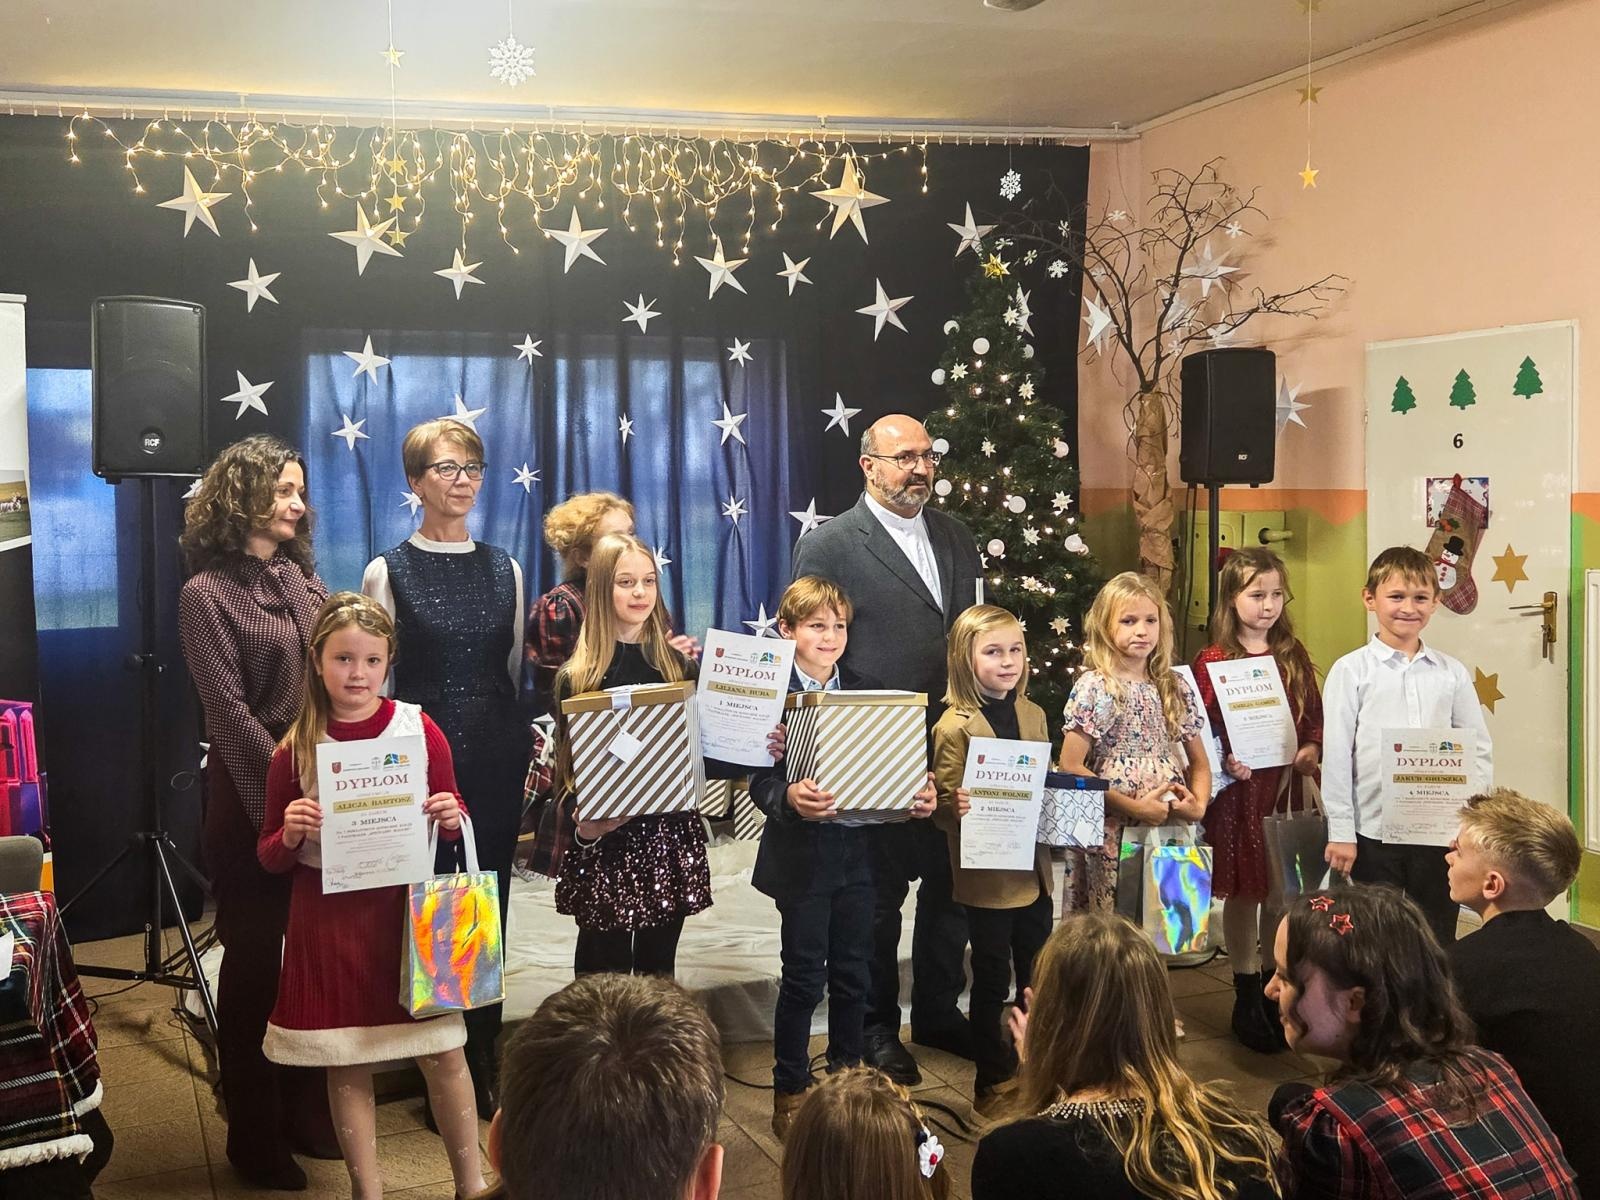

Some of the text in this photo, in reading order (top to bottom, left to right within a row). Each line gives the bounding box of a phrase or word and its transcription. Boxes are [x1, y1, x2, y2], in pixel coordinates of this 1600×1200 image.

[144, 438, 160, 447] RCF
[1453, 433, 1464, 449] 6
[712, 662, 776, 681] DYPLOM
[1225, 683, 1273, 696] DYPLOM
[726, 701, 758, 711] MIEJSCA
[1397, 757, 1462, 767] DYPLOM
[335, 773, 409, 791] DYPLOM
[976, 770, 1032, 783] DYPLOM
[336, 796, 411, 811] ALICJA BARTOSZ
[360, 816, 397, 825] MIEJSCA
